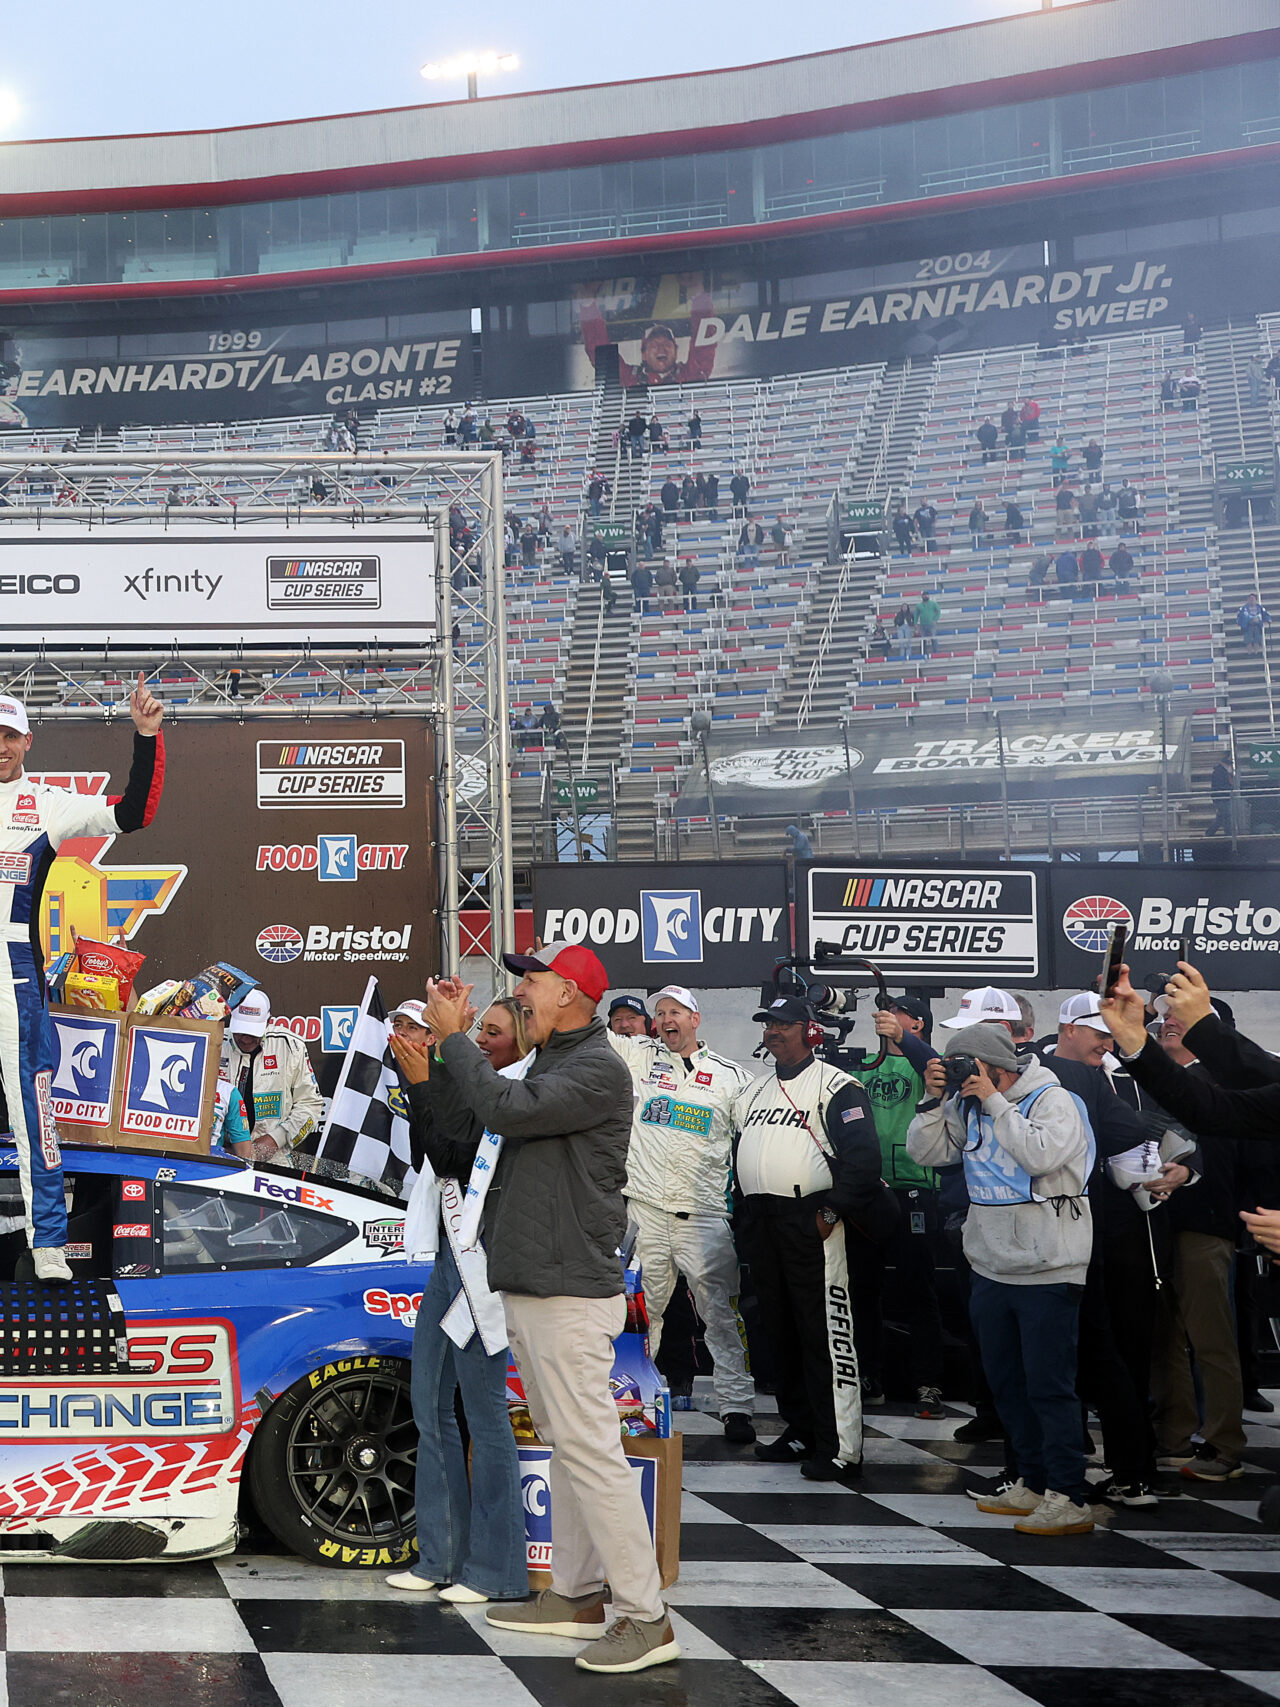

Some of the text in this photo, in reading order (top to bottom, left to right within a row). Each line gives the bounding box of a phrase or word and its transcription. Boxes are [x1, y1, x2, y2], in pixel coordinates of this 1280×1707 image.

[916, 250, 992, 278] 2004
[695, 260, 1175, 347] DALE EARNHARDT Jr.
[1053, 296, 1169, 331] SWEEP
[208, 330, 262, 352] 1999
[18, 339, 463, 398] EARNHARDT/LABONTE
[325, 374, 453, 406] CLASH #2
[303, 562, 363, 577] NASCAR
[123, 567, 224, 601] xfinity
[284, 582, 364, 599] CUP SERIES
[304, 746, 384, 765] NASCAR
[913, 731, 1154, 757] TRACKER
[891, 752, 1018, 771] BOATS
[1028, 756, 1048, 766] &
[277, 775, 386, 794] CUP SERIES
[256, 846, 318, 870] FOOD
[357, 845, 408, 869] CITY
[883, 878, 1003, 909] NASCAR
[543, 907, 639, 944] FOOD
[703, 907, 783, 942] CITY
[1137, 897, 1280, 935] Bristo
[305, 924, 412, 951] Bristol
[842, 925, 1007, 954] CUP SERIES
[303, 951, 406, 963] Motor Speedway
[649, 1071, 672, 1082] FedEx
[872, 1077, 900, 1093] FOX
[78, 1103, 107, 1119] CITY
[253, 1095, 281, 1104] MAVIS
[673, 1104, 711, 1118] MAVIS
[127, 1112, 197, 1133] FOOD CITY
[253, 1175, 335, 1212] FedEx
[829, 1284, 858, 1390] OFFICIAL
[308, 1356, 381, 1389] EAGLE
